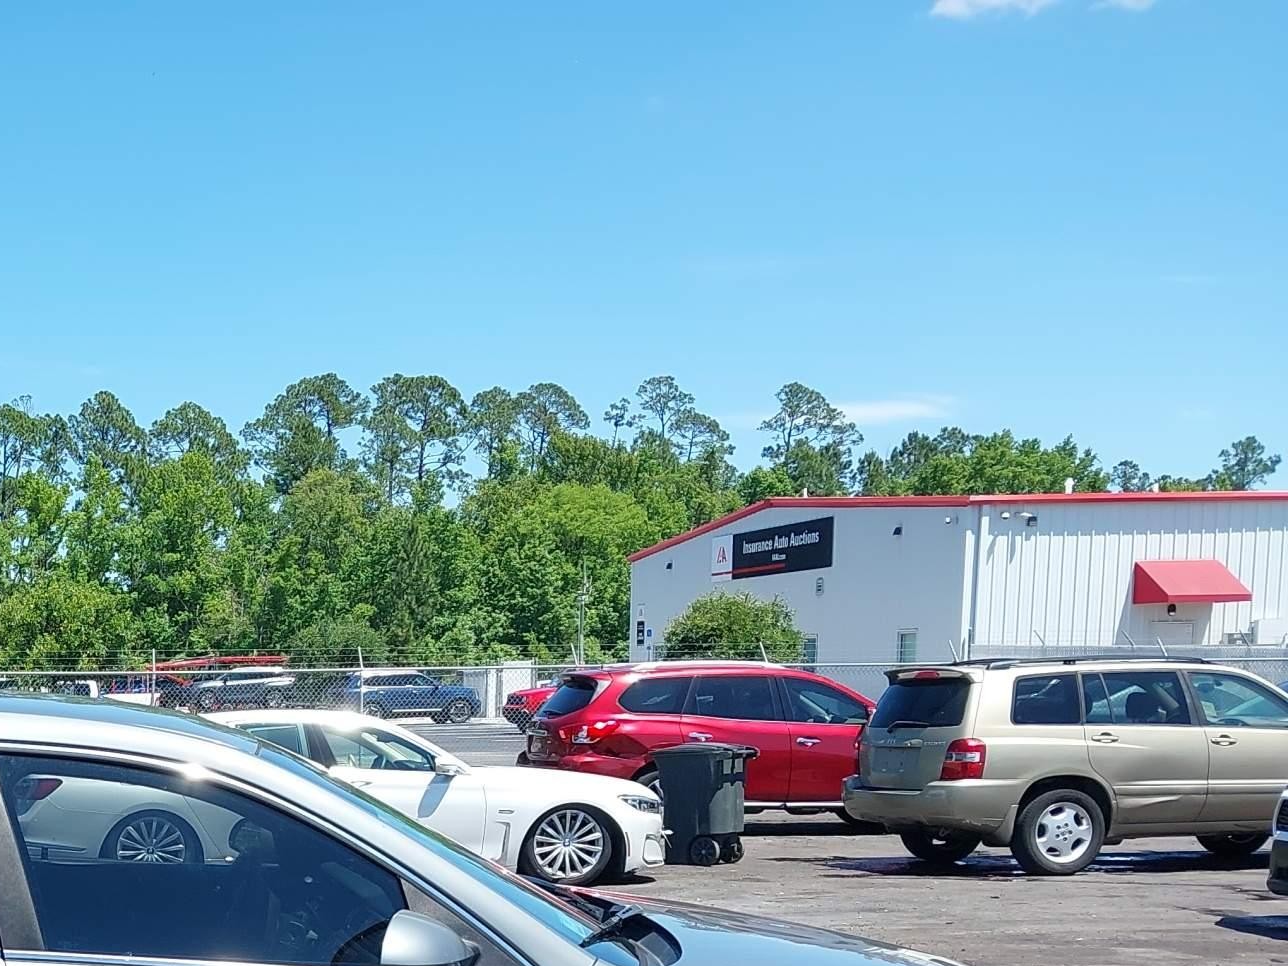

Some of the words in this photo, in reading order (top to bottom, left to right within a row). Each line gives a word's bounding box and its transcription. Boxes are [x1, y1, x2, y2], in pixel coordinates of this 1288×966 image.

[742, 539, 772, 554] Insurance
[773, 535, 789, 549] Auto
[790, 530, 820, 547] Auctions
